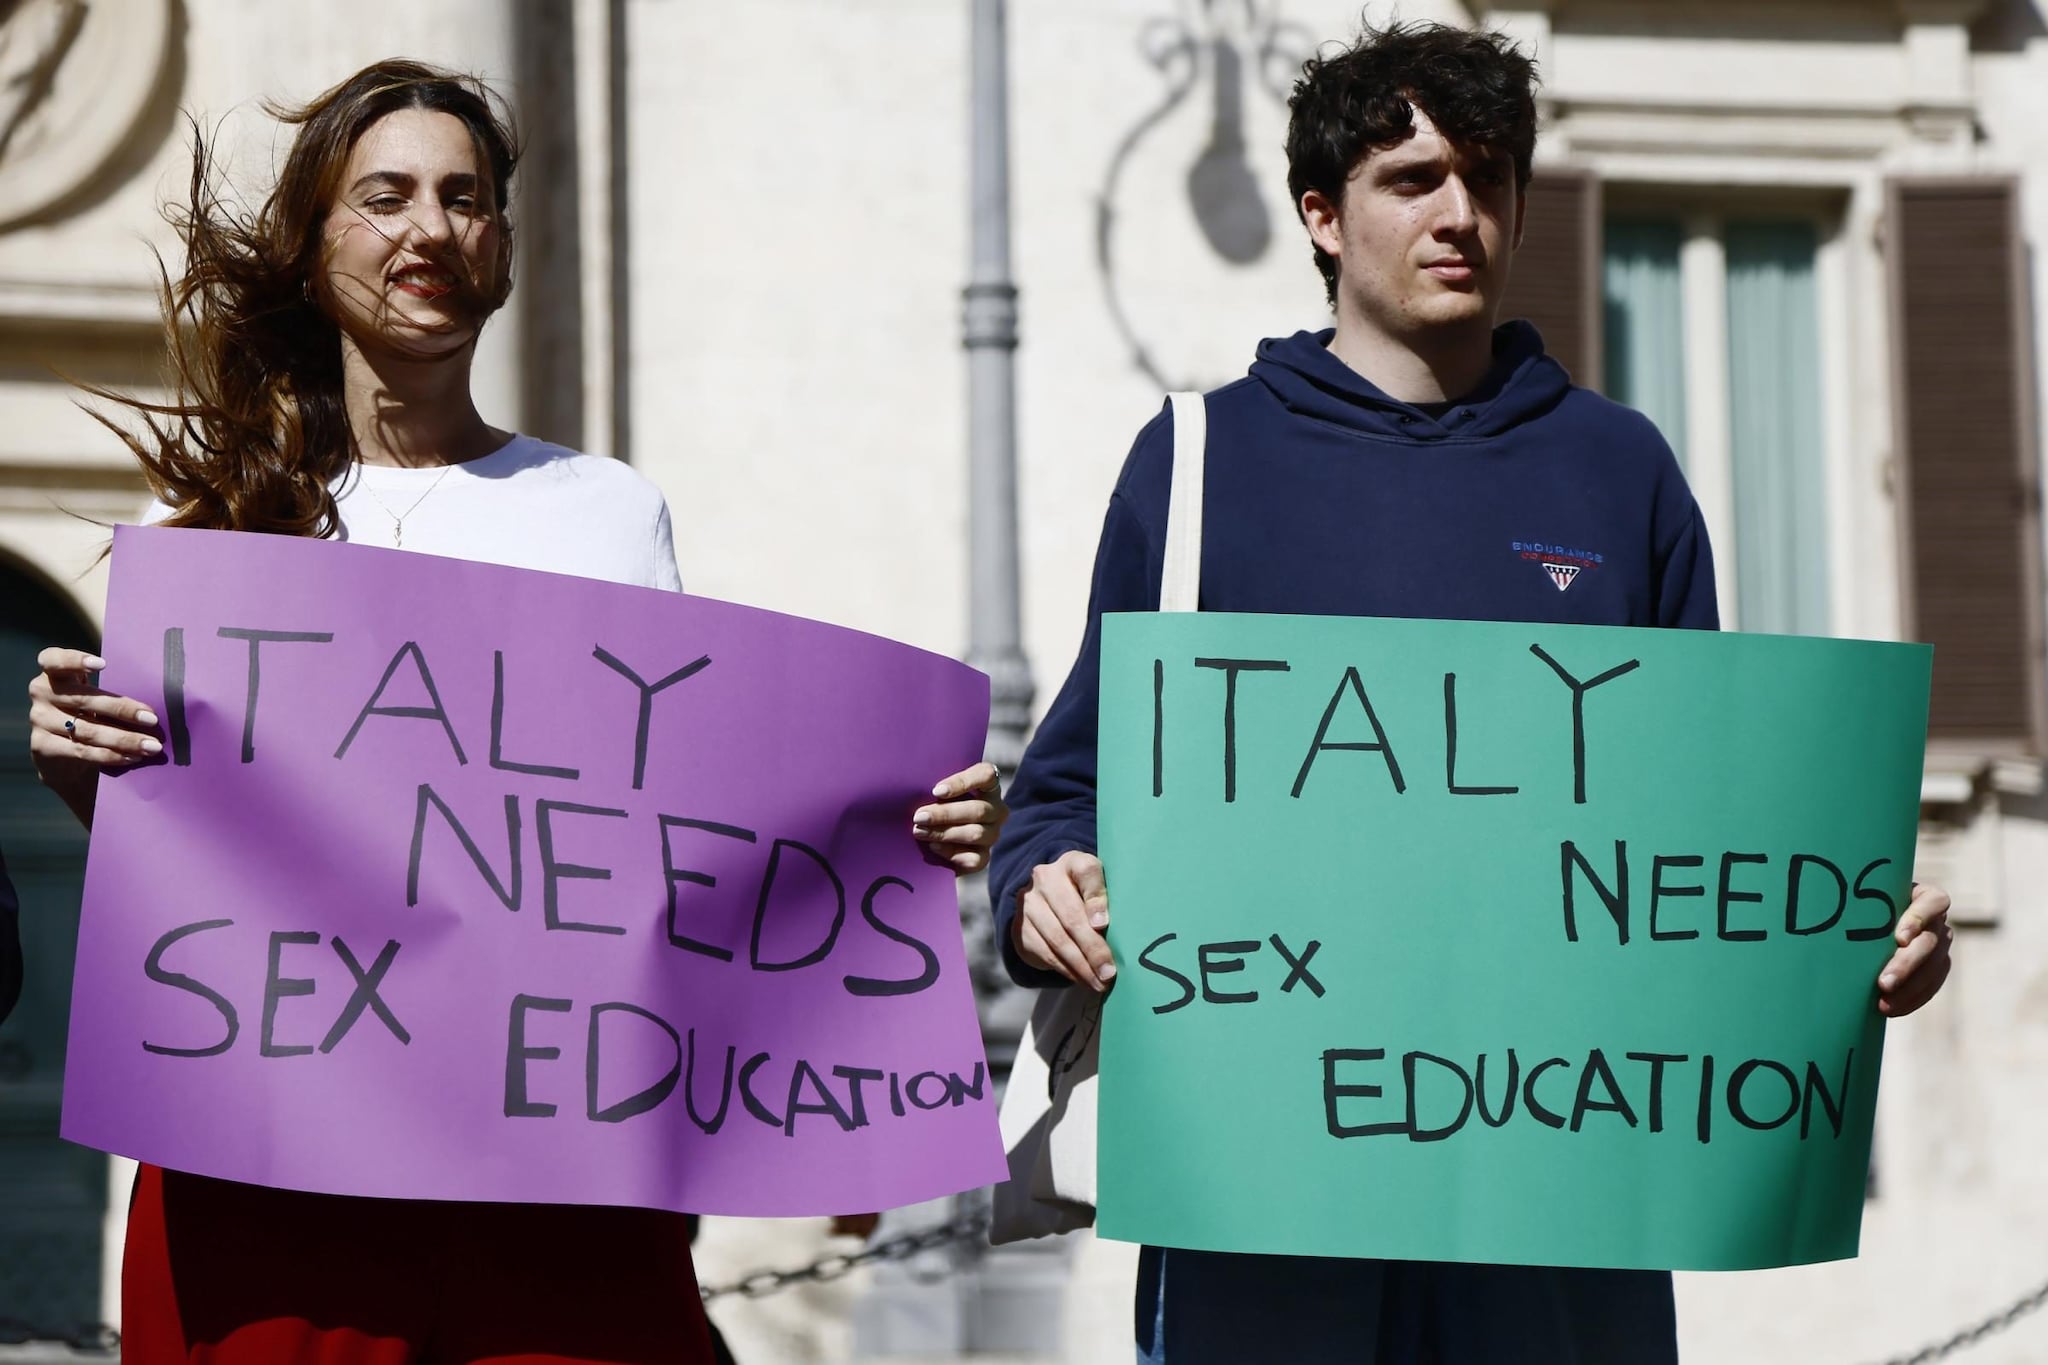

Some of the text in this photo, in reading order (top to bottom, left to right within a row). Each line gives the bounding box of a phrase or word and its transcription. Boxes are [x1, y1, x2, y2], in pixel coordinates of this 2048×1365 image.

[163, 626, 711, 790] ITALY
[1152, 643, 1640, 804] ITALY
[406, 783, 941, 997] NEEDS
[1560, 838, 1897, 946] NEEDS
[142, 917, 411, 1058] SEX
[1137, 933, 1327, 1015] SEX
[503, 993, 986, 1137] EDUCATION
[1318, 1046, 1855, 1145] EDUCATION
